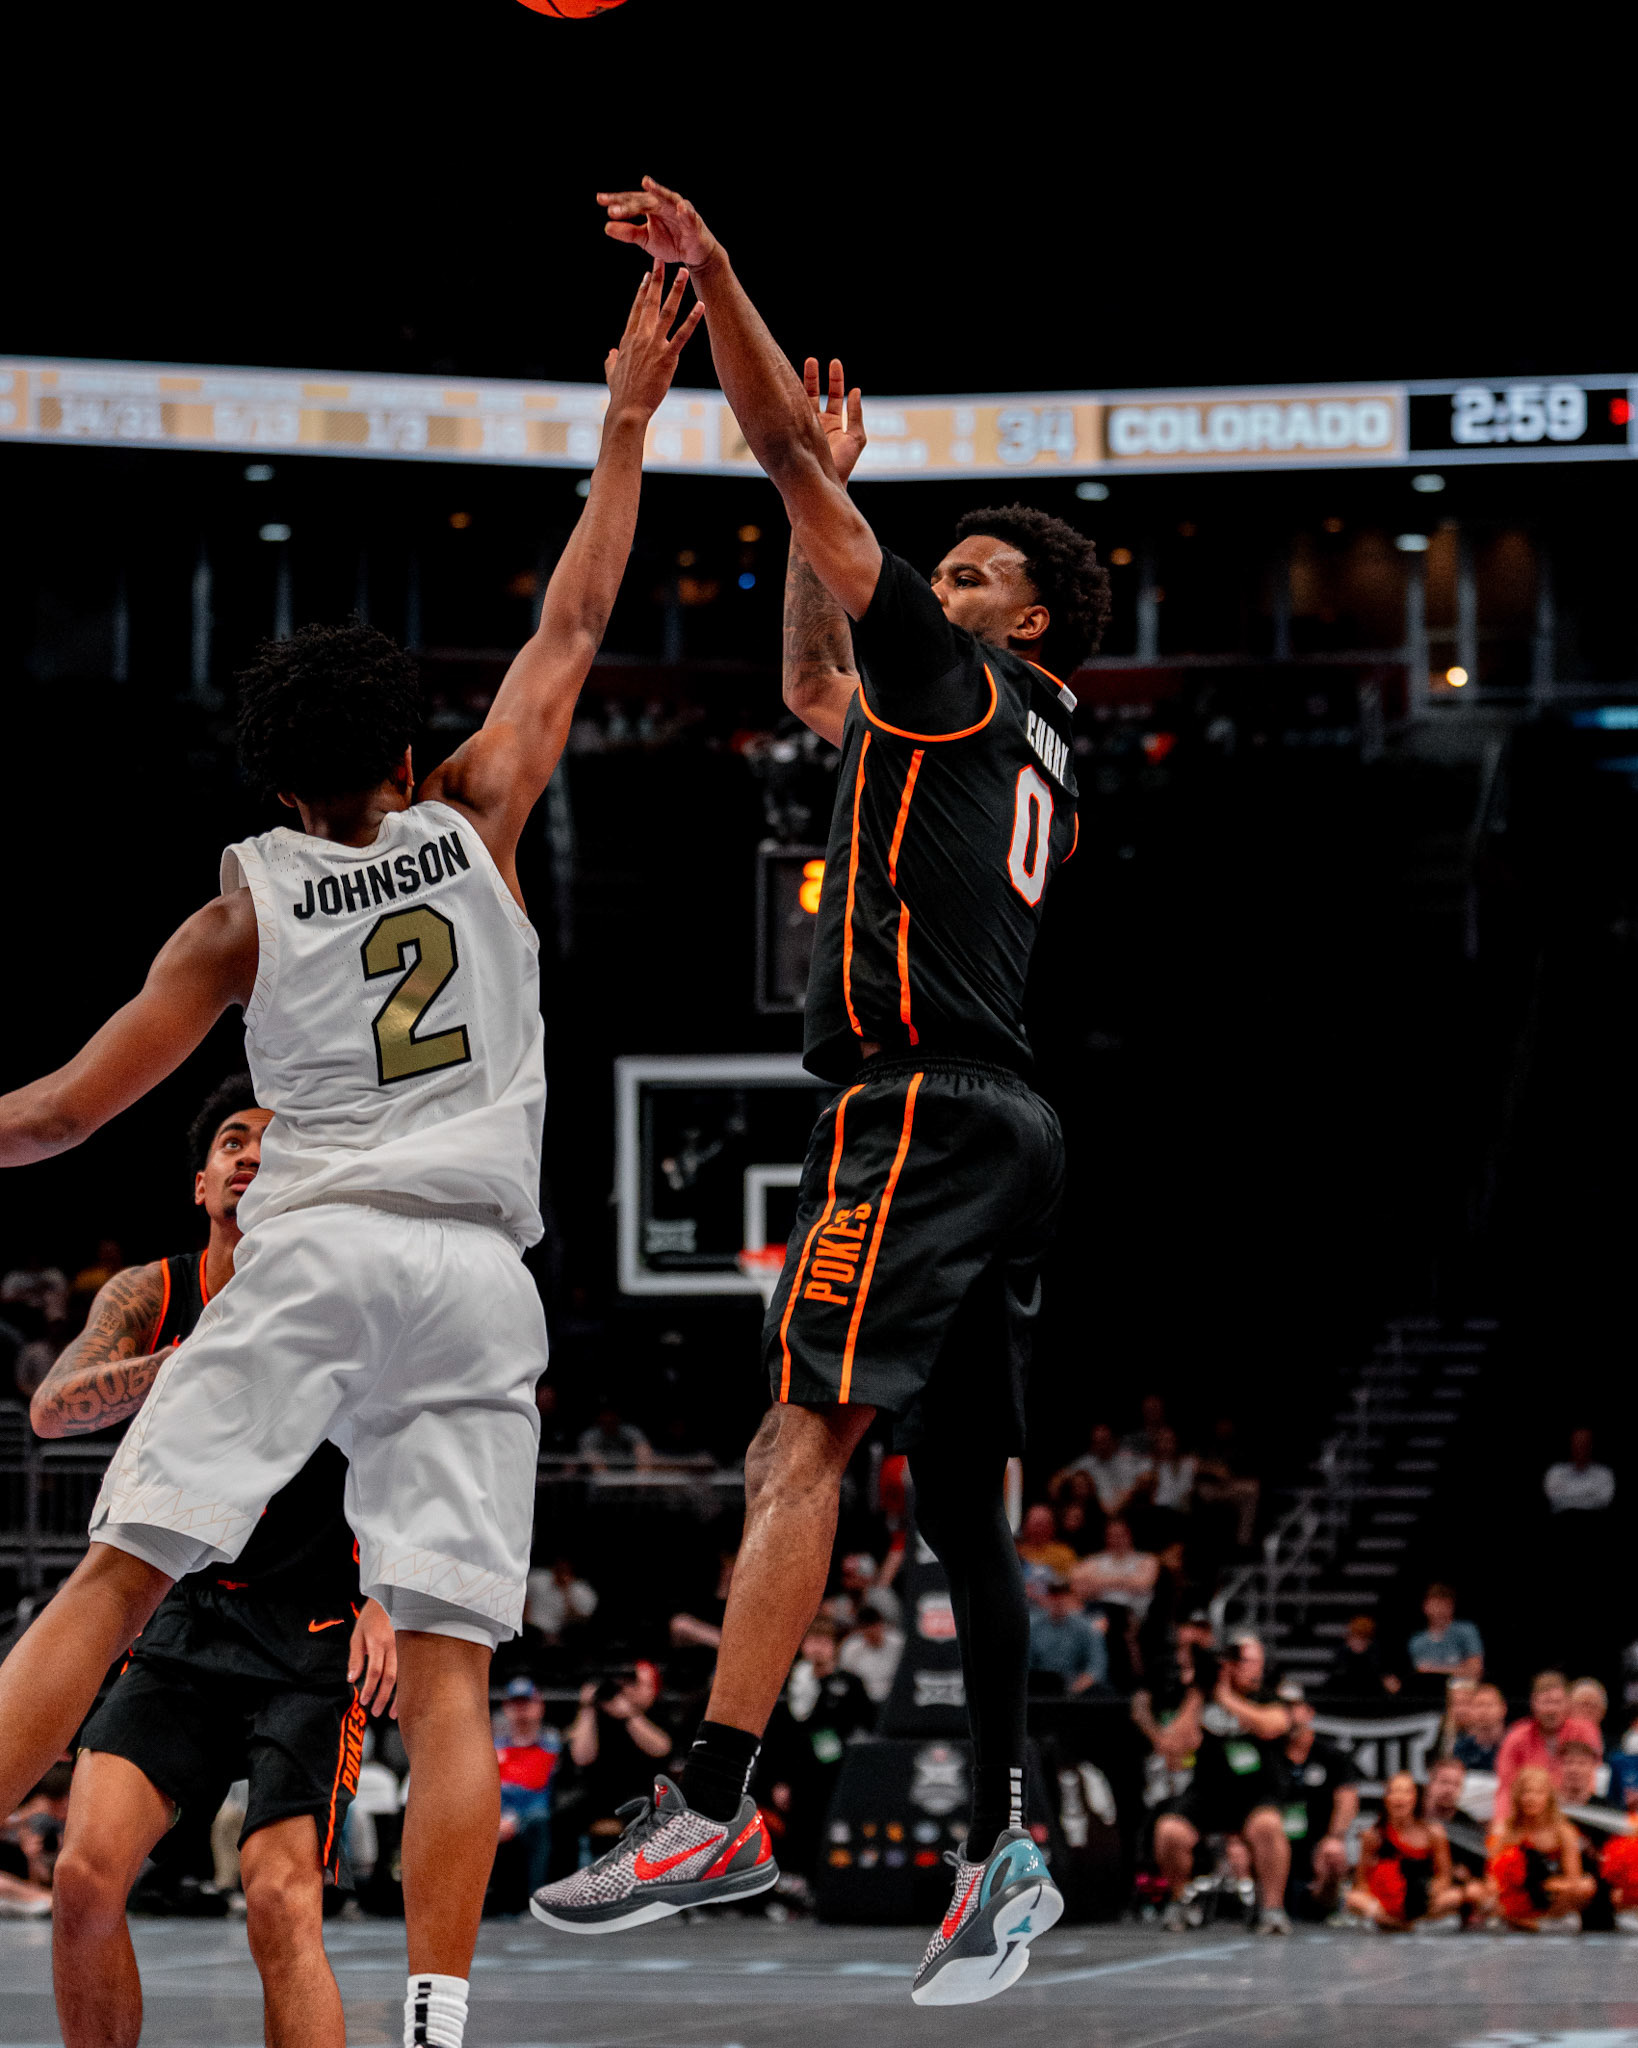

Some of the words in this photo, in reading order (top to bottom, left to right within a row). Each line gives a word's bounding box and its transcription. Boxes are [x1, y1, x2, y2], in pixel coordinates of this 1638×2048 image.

[996, 406, 1076, 465] 34
[1108, 400, 1391, 455] COLORADO
[1450, 383, 1588, 444] 2:59
[1026, 709, 1070, 786] CURRY
[293, 830, 471, 920] JOHNSON
[1006, 763, 1054, 908] 0
[360, 903, 472, 1087] 2
[803, 1202, 873, 1306] POKES
[341, 1702, 367, 1796] POKES
